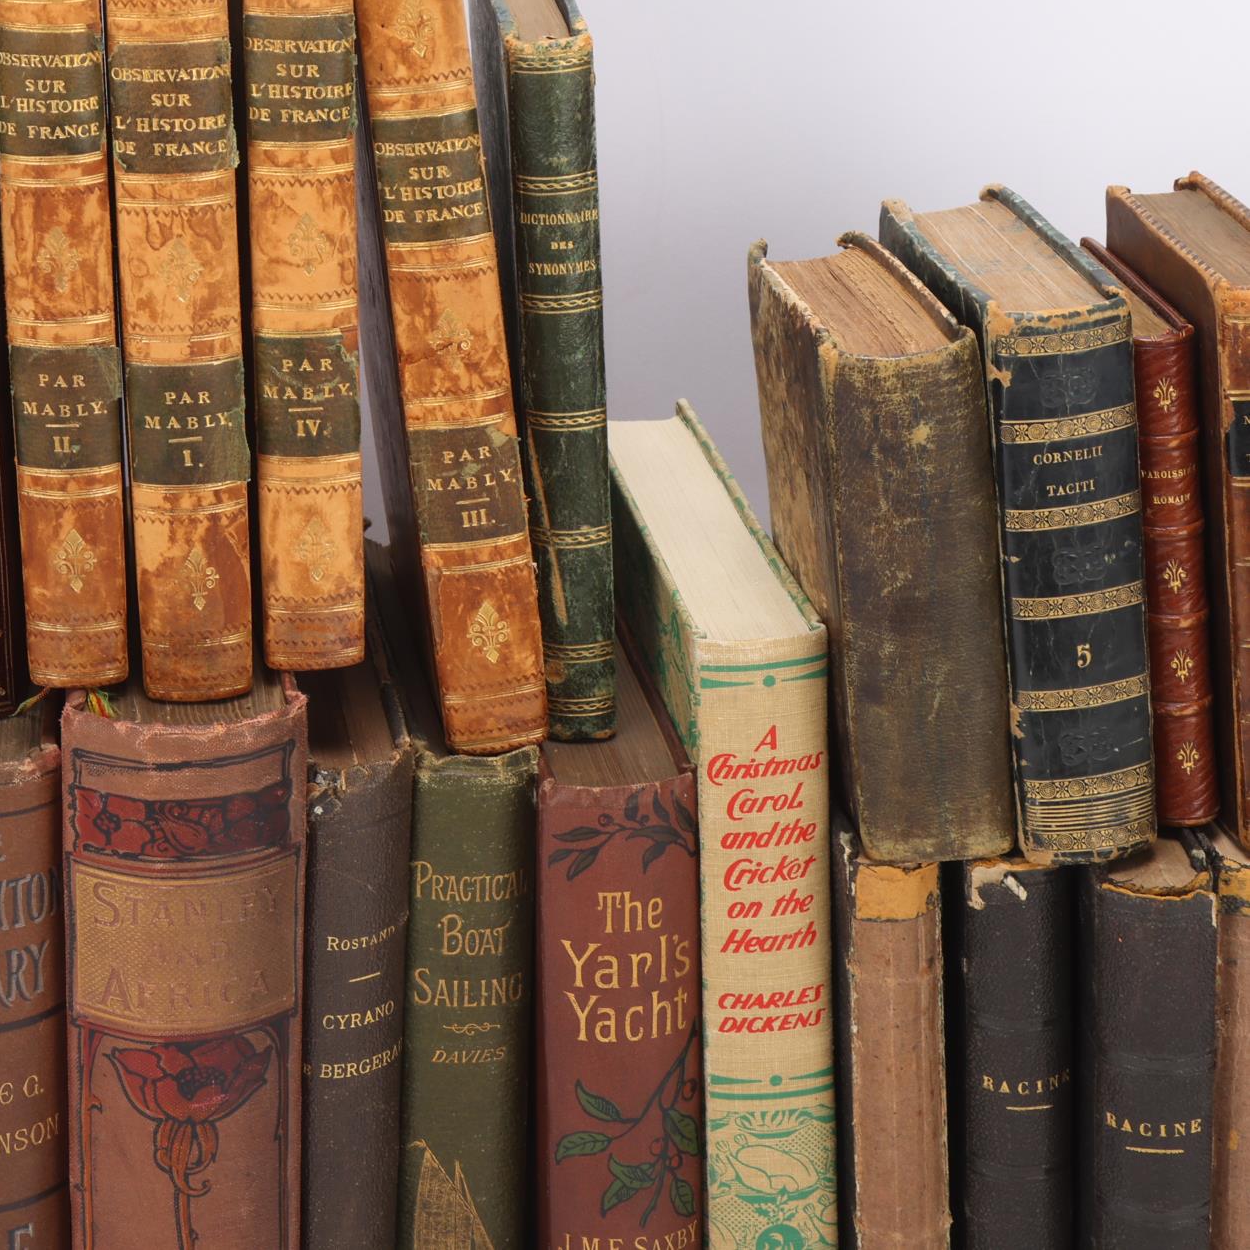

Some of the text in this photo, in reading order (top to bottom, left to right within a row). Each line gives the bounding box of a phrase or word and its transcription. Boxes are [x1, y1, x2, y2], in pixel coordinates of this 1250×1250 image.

[276, 63, 320, 78] SUR
[25, 79, 67, 94] SUR
[251, 81, 354, 100] L'HISTOIRE
[0, 95, 99, 114] L'HISTOIRE
[150, 93, 192, 107] SUR
[115, 113, 227, 133] L'HISTOIRE
[249, 106, 351, 123] DE FRANCE
[26, 122, 100, 140] FRANCE
[114, 139, 228, 157] DE FRANCE
[408, 165, 452, 180] SUR
[384, 177, 484, 202] L'HISTOIRE
[384, 201, 484, 223] DE FRANCE
[520, 208, 599, 225] DICTIONNAIRE
[550, 240, 575, 250] DES
[528, 259, 596, 276] SYNONYMES
[281, 358, 334, 372] PAR
[38, 373, 86, 389] PAR
[262, 383, 354, 400] MABLY.
[164, 391, 211, 405] PAR
[23, 401, 108, 418] MABLY.
[144, 412, 232, 429] MABLY.
[442, 446, 492, 464] PAR
[1033, 445, 1103, 466] CORNELII
[427, 468, 516, 491] MABLY.
[1046, 479, 1096, 498] TACITI
[1153, 493, 1191, 505] ROMAIN
[461, 509, 496, 528] III.
[1076, 643, 1092, 669] 5
[753, 724, 778, 752] A
[706, 751, 824, 786] Christmas
[726, 781, 805, 821] Carol
[720, 818, 817, 850] and the
[723, 854, 817, 892] Cricket
[92, 881, 277, 928] STANLEY
[597, 891, 663, 933] The
[726, 889, 815, 919] on the
[440, 914, 510, 956] BOAT
[719, 921, 818, 954] Hearth
[560, 934, 691, 989] Yarl's
[101, 966, 270, 1018] AFRICA
[414, 967, 523, 1007] SAILING
[717, 984, 825, 1011] CHARLES
[322, 1000, 394, 1030] CYRANO
[563, 987, 687, 1043] Yacht
[718, 1008, 826, 1035] DICKENS
[431, 1046, 507, 1064] DAVIES
[22, 1074, 45, 1099] G.
[983, 1068, 1070, 1095] RACINE
[1106, 1111, 1202, 1138] RACINE
